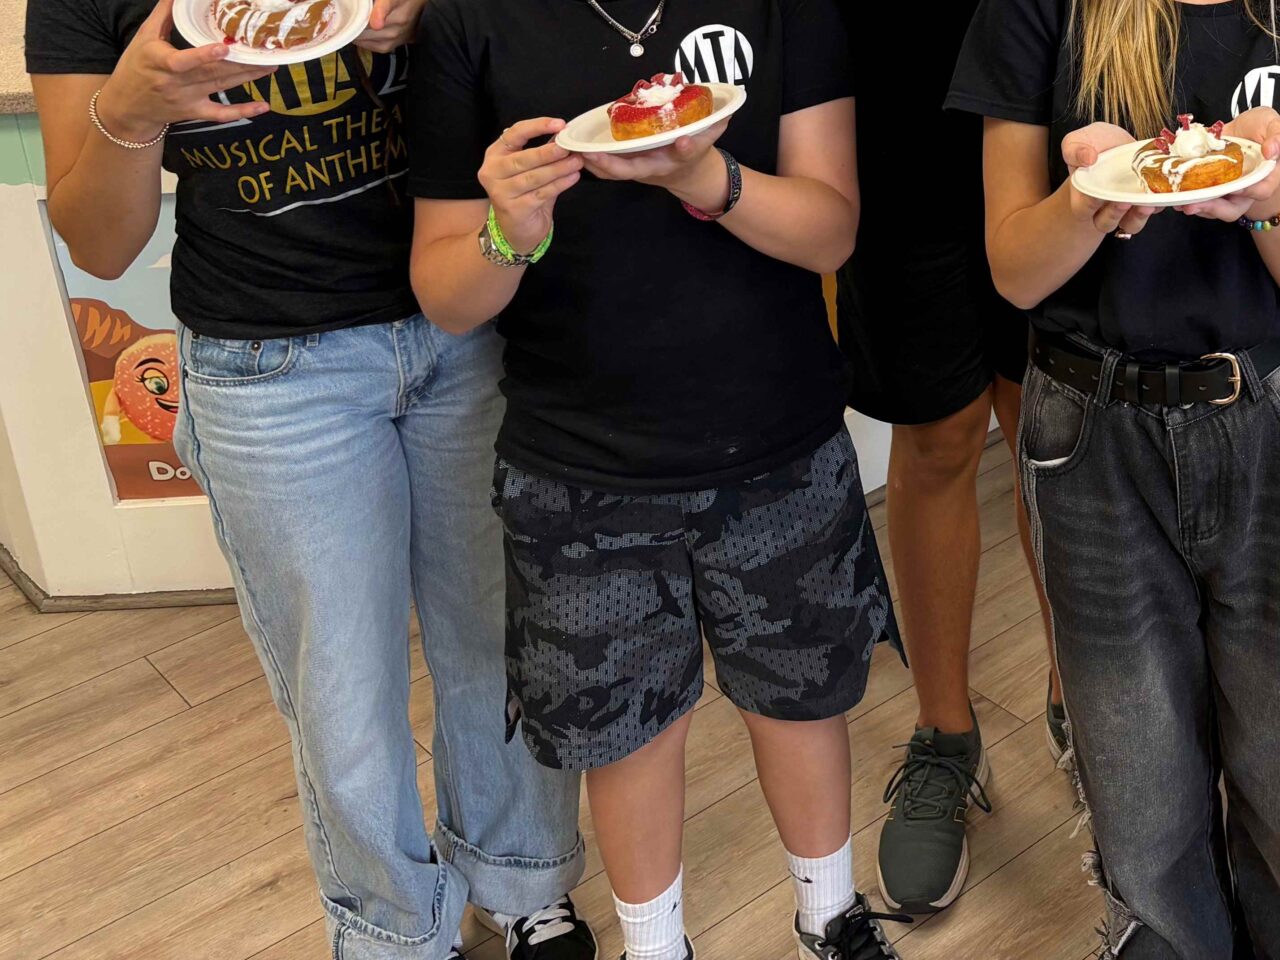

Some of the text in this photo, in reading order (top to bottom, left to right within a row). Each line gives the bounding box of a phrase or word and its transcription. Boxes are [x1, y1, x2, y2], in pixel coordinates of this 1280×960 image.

[677, 26, 752, 86] MTA
[181, 104, 403, 170] MUSICAL THEA
[238, 171, 274, 204] OF
